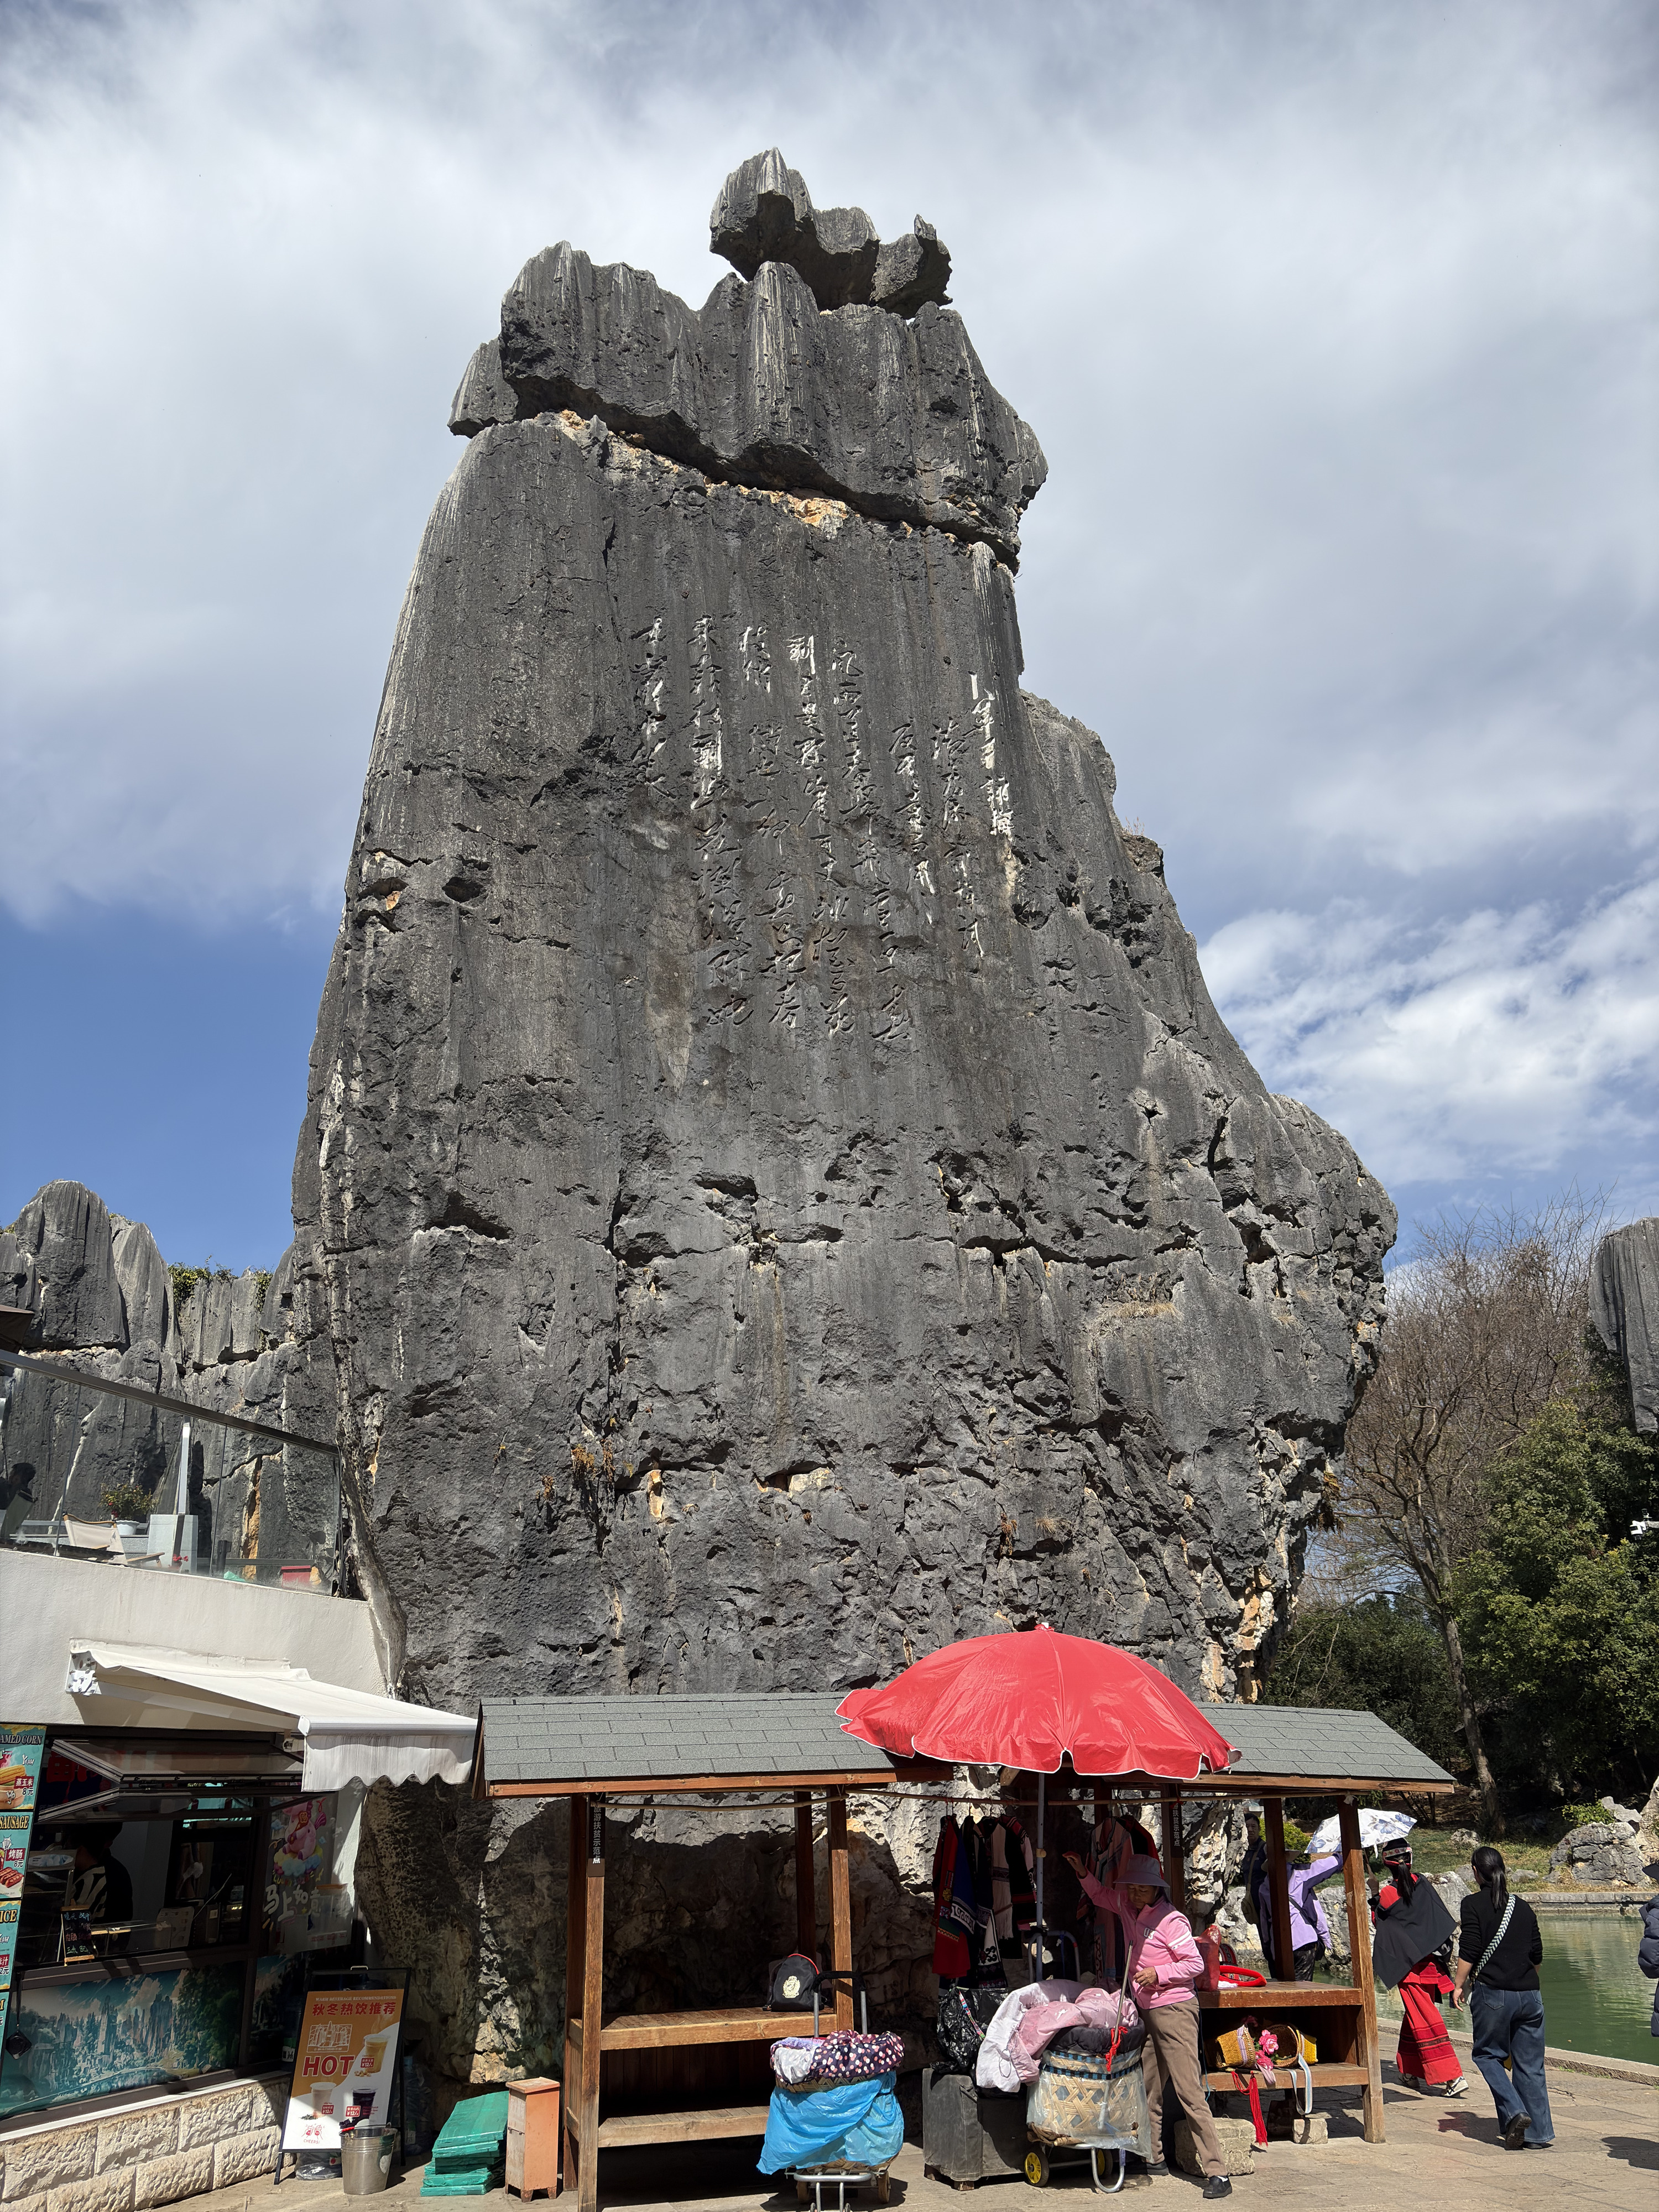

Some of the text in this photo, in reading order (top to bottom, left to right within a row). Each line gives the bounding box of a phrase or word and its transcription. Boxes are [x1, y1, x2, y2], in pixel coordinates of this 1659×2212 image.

[22, 1735, 43, 1745] CORN
[15, 1778, 33, 1787] 蒸玉米
[0, 1815, 29, 1830] SAUSAGE
[8, 1849, 23, 1859] 烤肠
[263, 1884, 321, 1923] 马上如意
[312, 2002, 397, 2016] 秋冬热饮推荐
[302, 2055, 355, 2077] HOT
